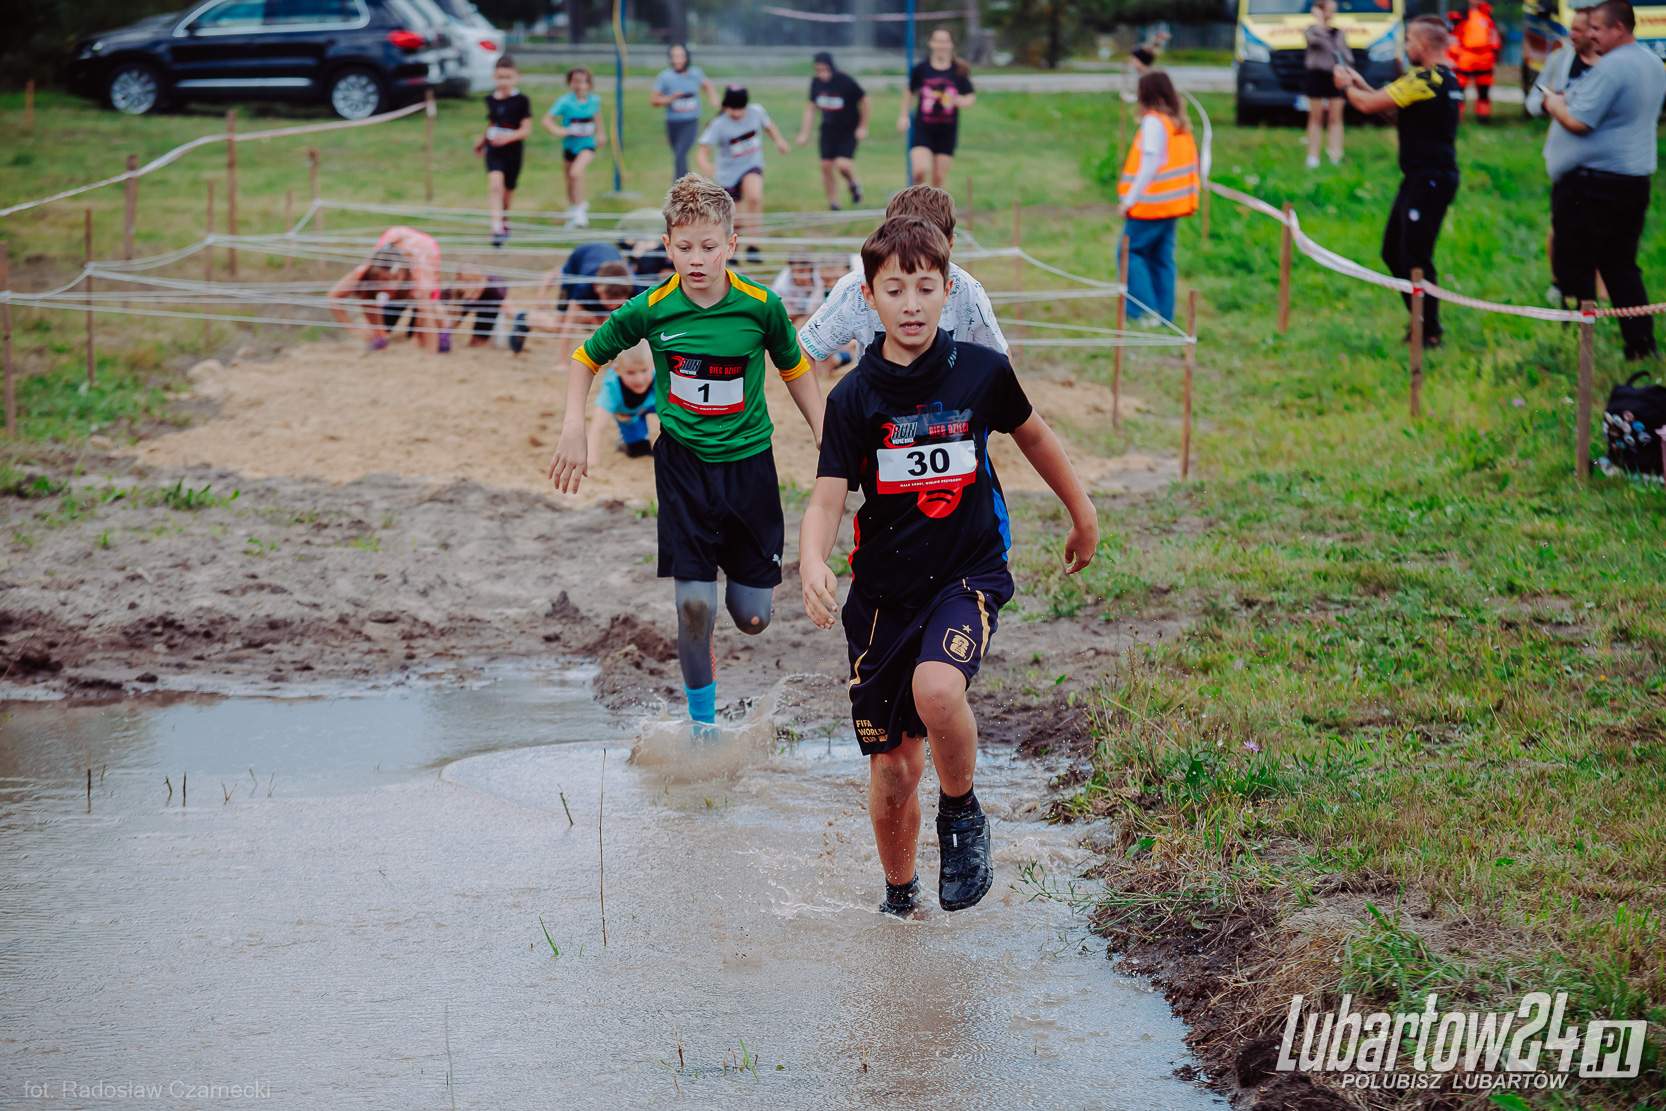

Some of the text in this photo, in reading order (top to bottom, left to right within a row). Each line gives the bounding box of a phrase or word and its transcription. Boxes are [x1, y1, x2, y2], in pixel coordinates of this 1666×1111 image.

[697, 383, 710, 403] 1
[947, 421, 969, 434] DZIECI
[906, 448, 950, 476] 30
[855, 720, 872, 728] FIFA
[857, 728, 886, 736] WORLD
